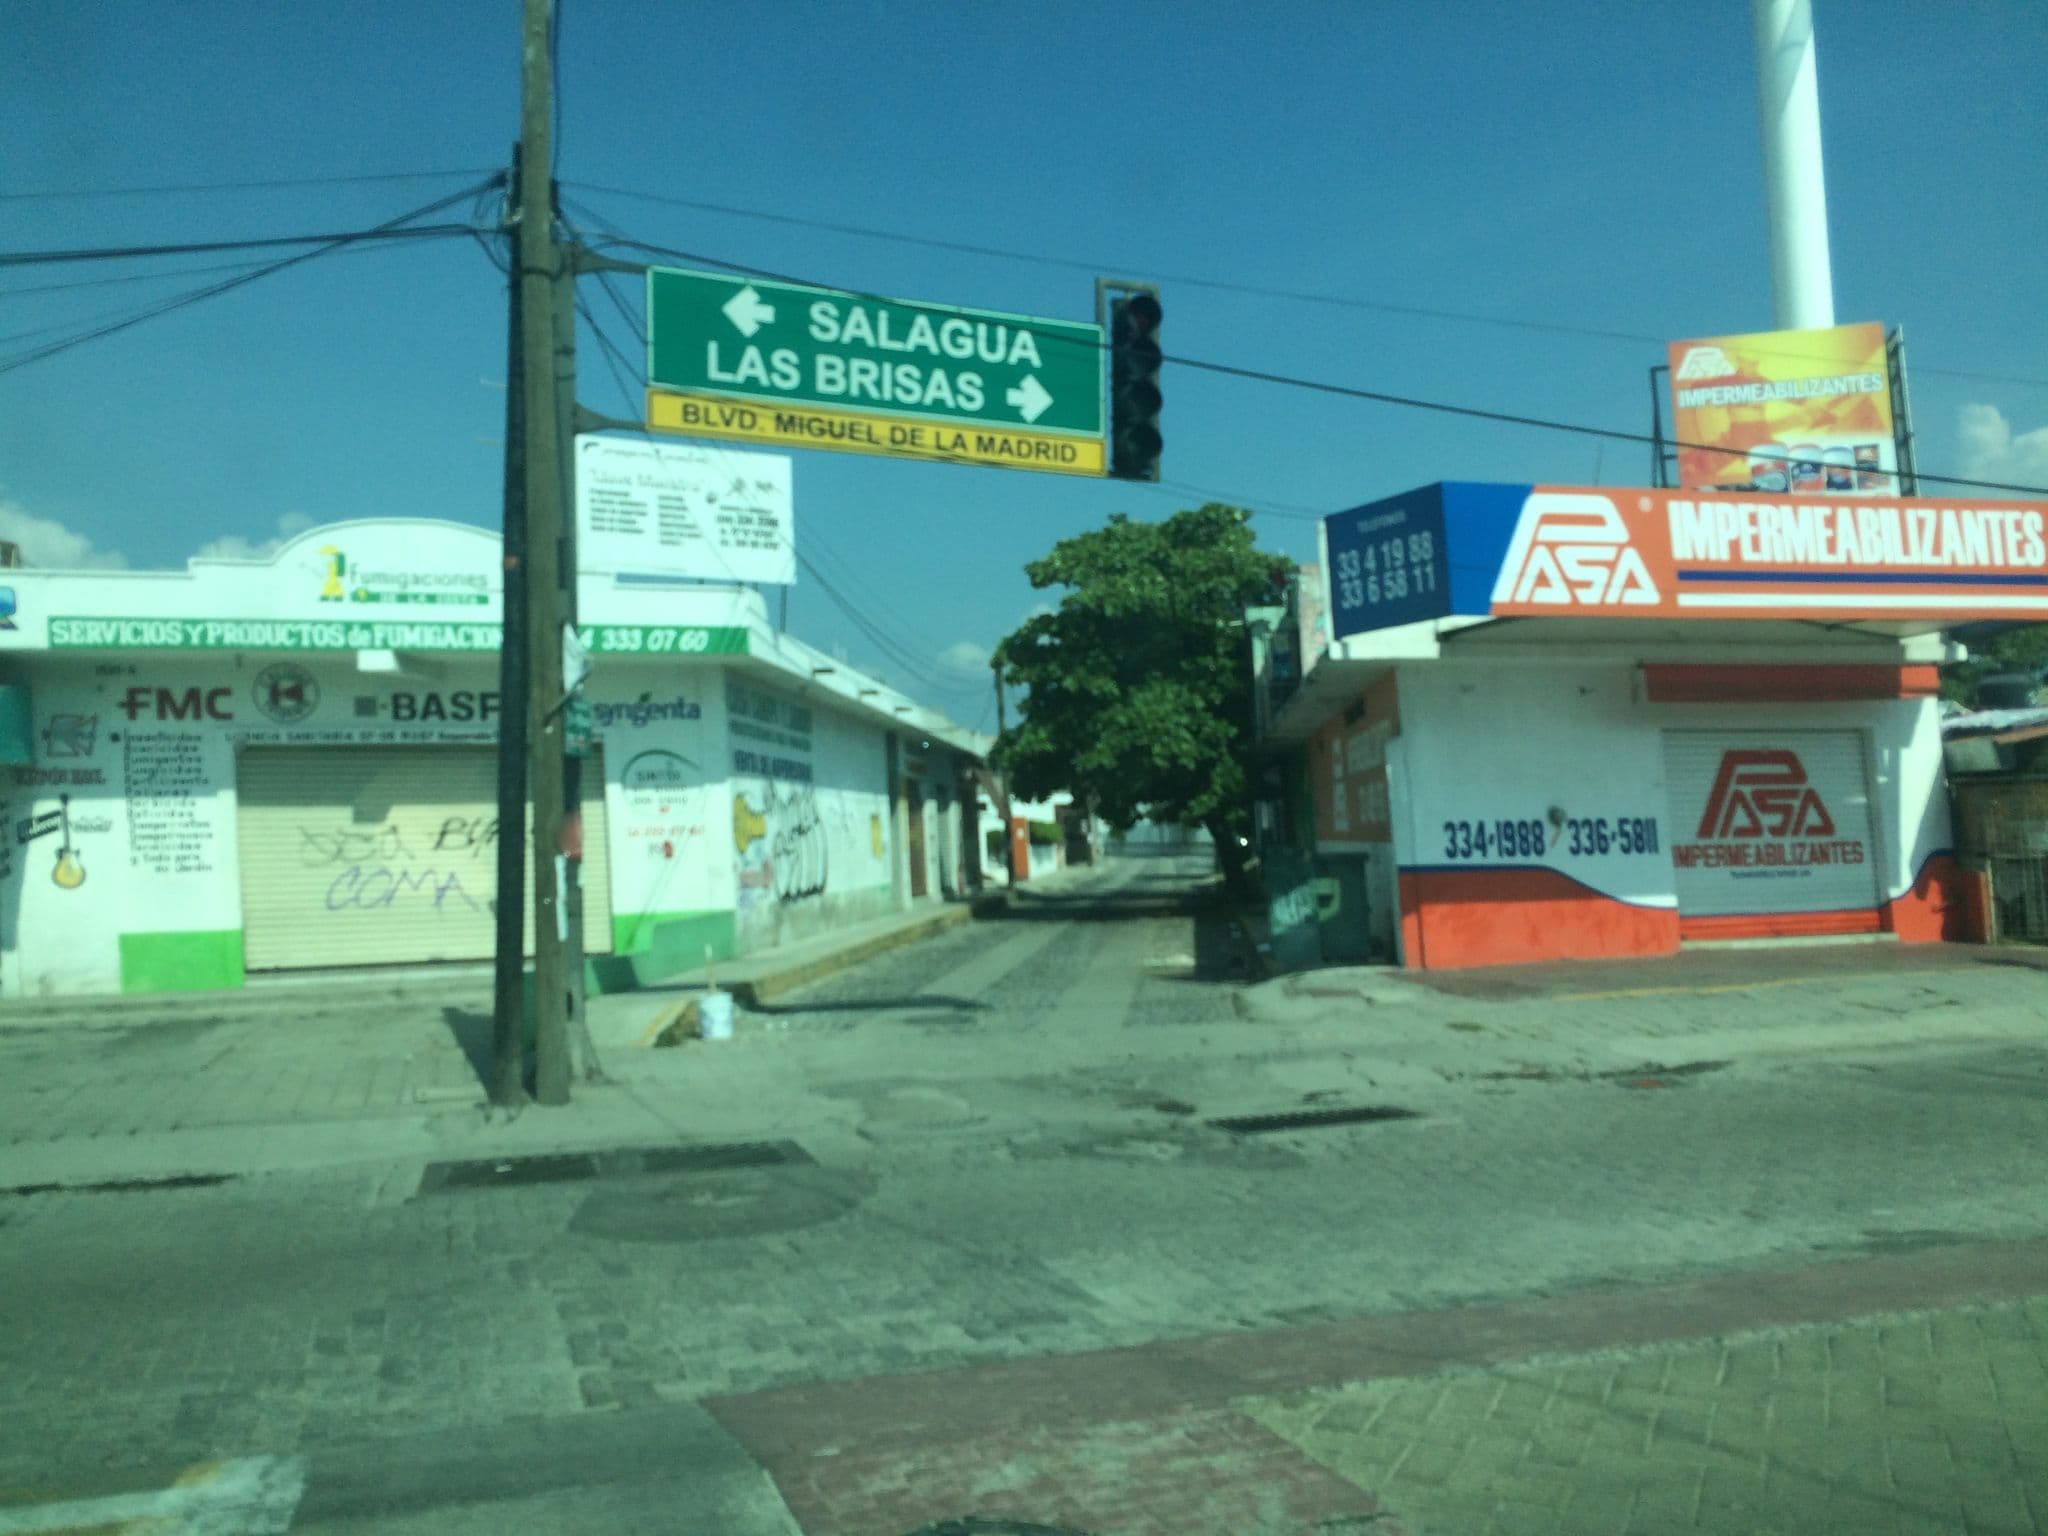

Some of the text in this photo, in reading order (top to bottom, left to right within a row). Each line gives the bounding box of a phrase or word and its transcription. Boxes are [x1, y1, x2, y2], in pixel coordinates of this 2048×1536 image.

[809, 301, 1042, 368] SALAGUA
[706, 340, 985, 412] LAS BRISAS
[1677, 373, 1885, 408] IMPERMEABILIZANTES
[774, 414, 881, 446] MIGUEL
[889, 425, 927, 448] DE
[935, 431, 966, 453] LA
[975, 435, 1078, 464] MADRID
[1667, 500, 2046, 568] IMPERMEABILIZANTES
[1337, 530, 1434, 580] 33 4 19 88
[1341, 579, 1364, 610] 33
[1368, 575, 1380, 603] 6
[1412, 562, 1435, 594] 11
[51, 619, 184, 645] SERVICIOS
[205, 622, 345, 648] PRODUCTOS
[347, 625, 371, 647] de
[601, 628, 643, 651] 333
[647, 629, 677, 651] 07
[679, 630, 709, 651] 60
[117, 687, 234, 721] FMC
[391, 691, 500, 721] BASF
[1671, 840, 1865, 869] IMPERMEABILIZANTES
